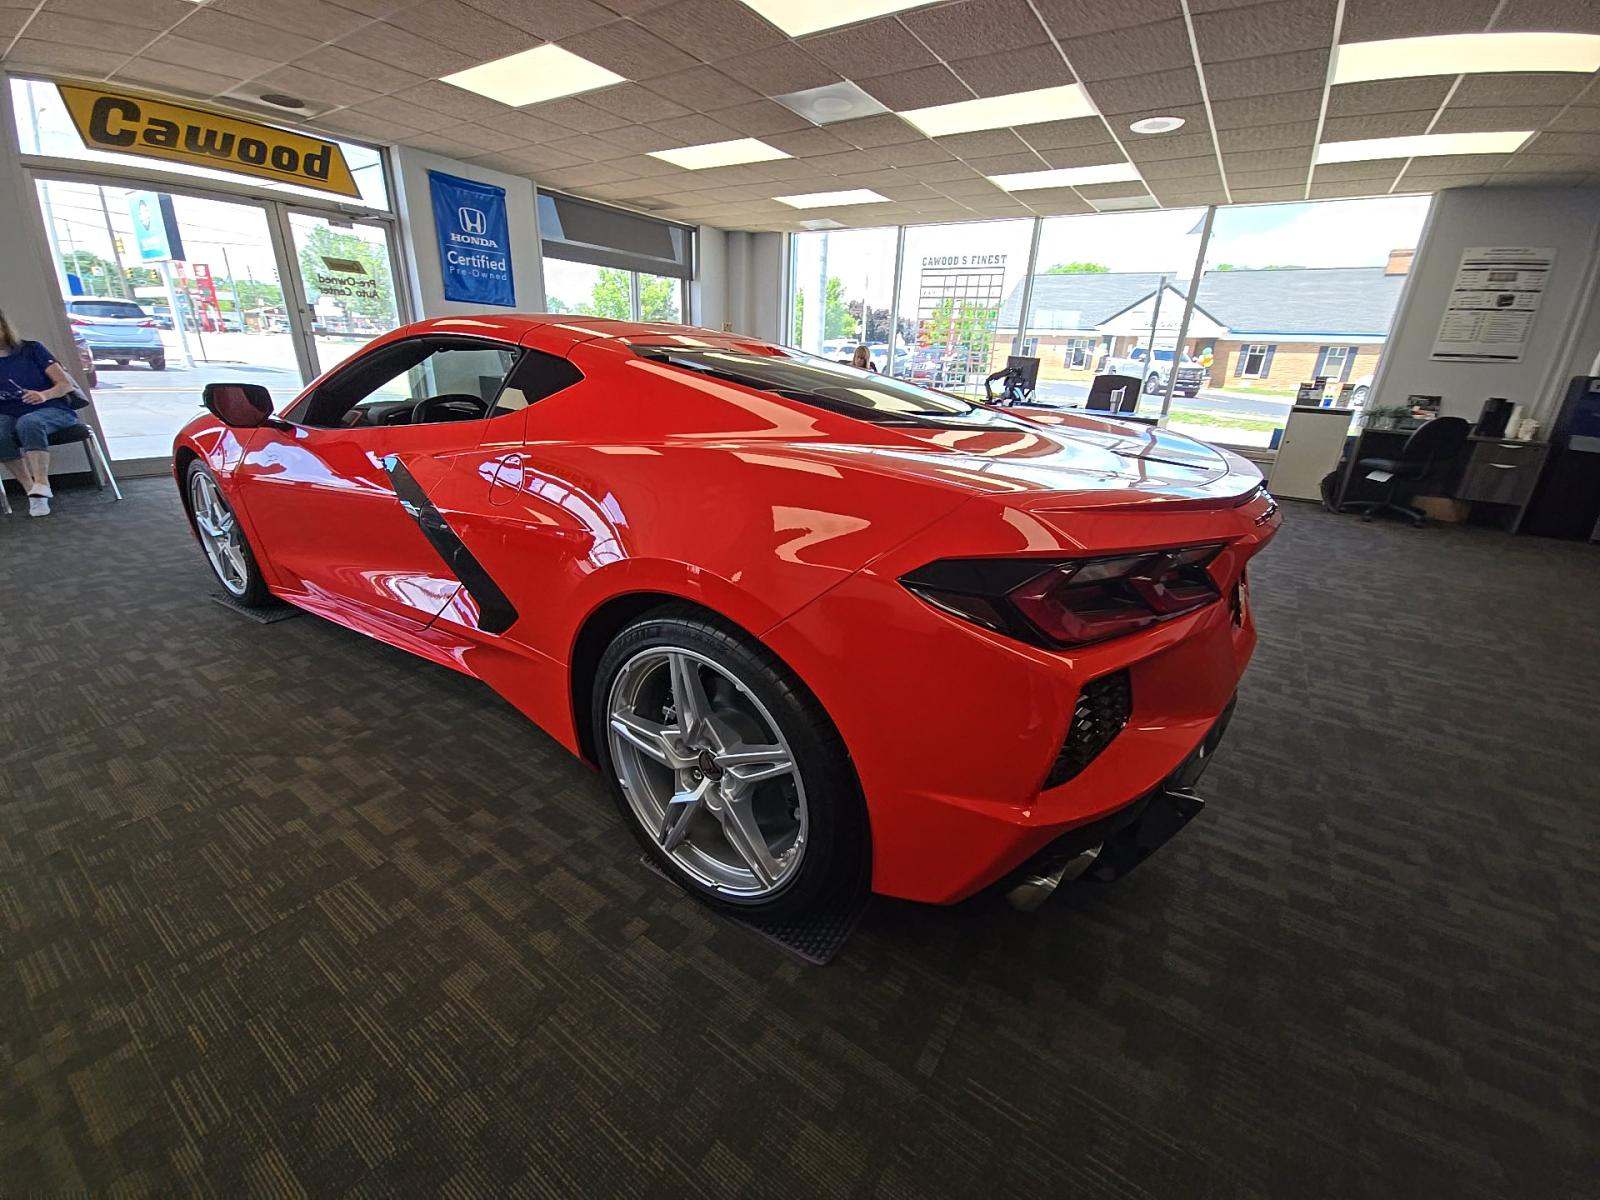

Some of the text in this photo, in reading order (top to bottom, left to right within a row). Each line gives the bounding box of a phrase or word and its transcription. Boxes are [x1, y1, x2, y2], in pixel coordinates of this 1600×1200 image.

[89, 96, 332, 180] Cawood
[450, 232, 498, 248] HONDA
[447, 250, 506, 271] Certified
[971, 254, 1008, 265] FINEST
[449, 265, 507, 281] Pre-Owned
